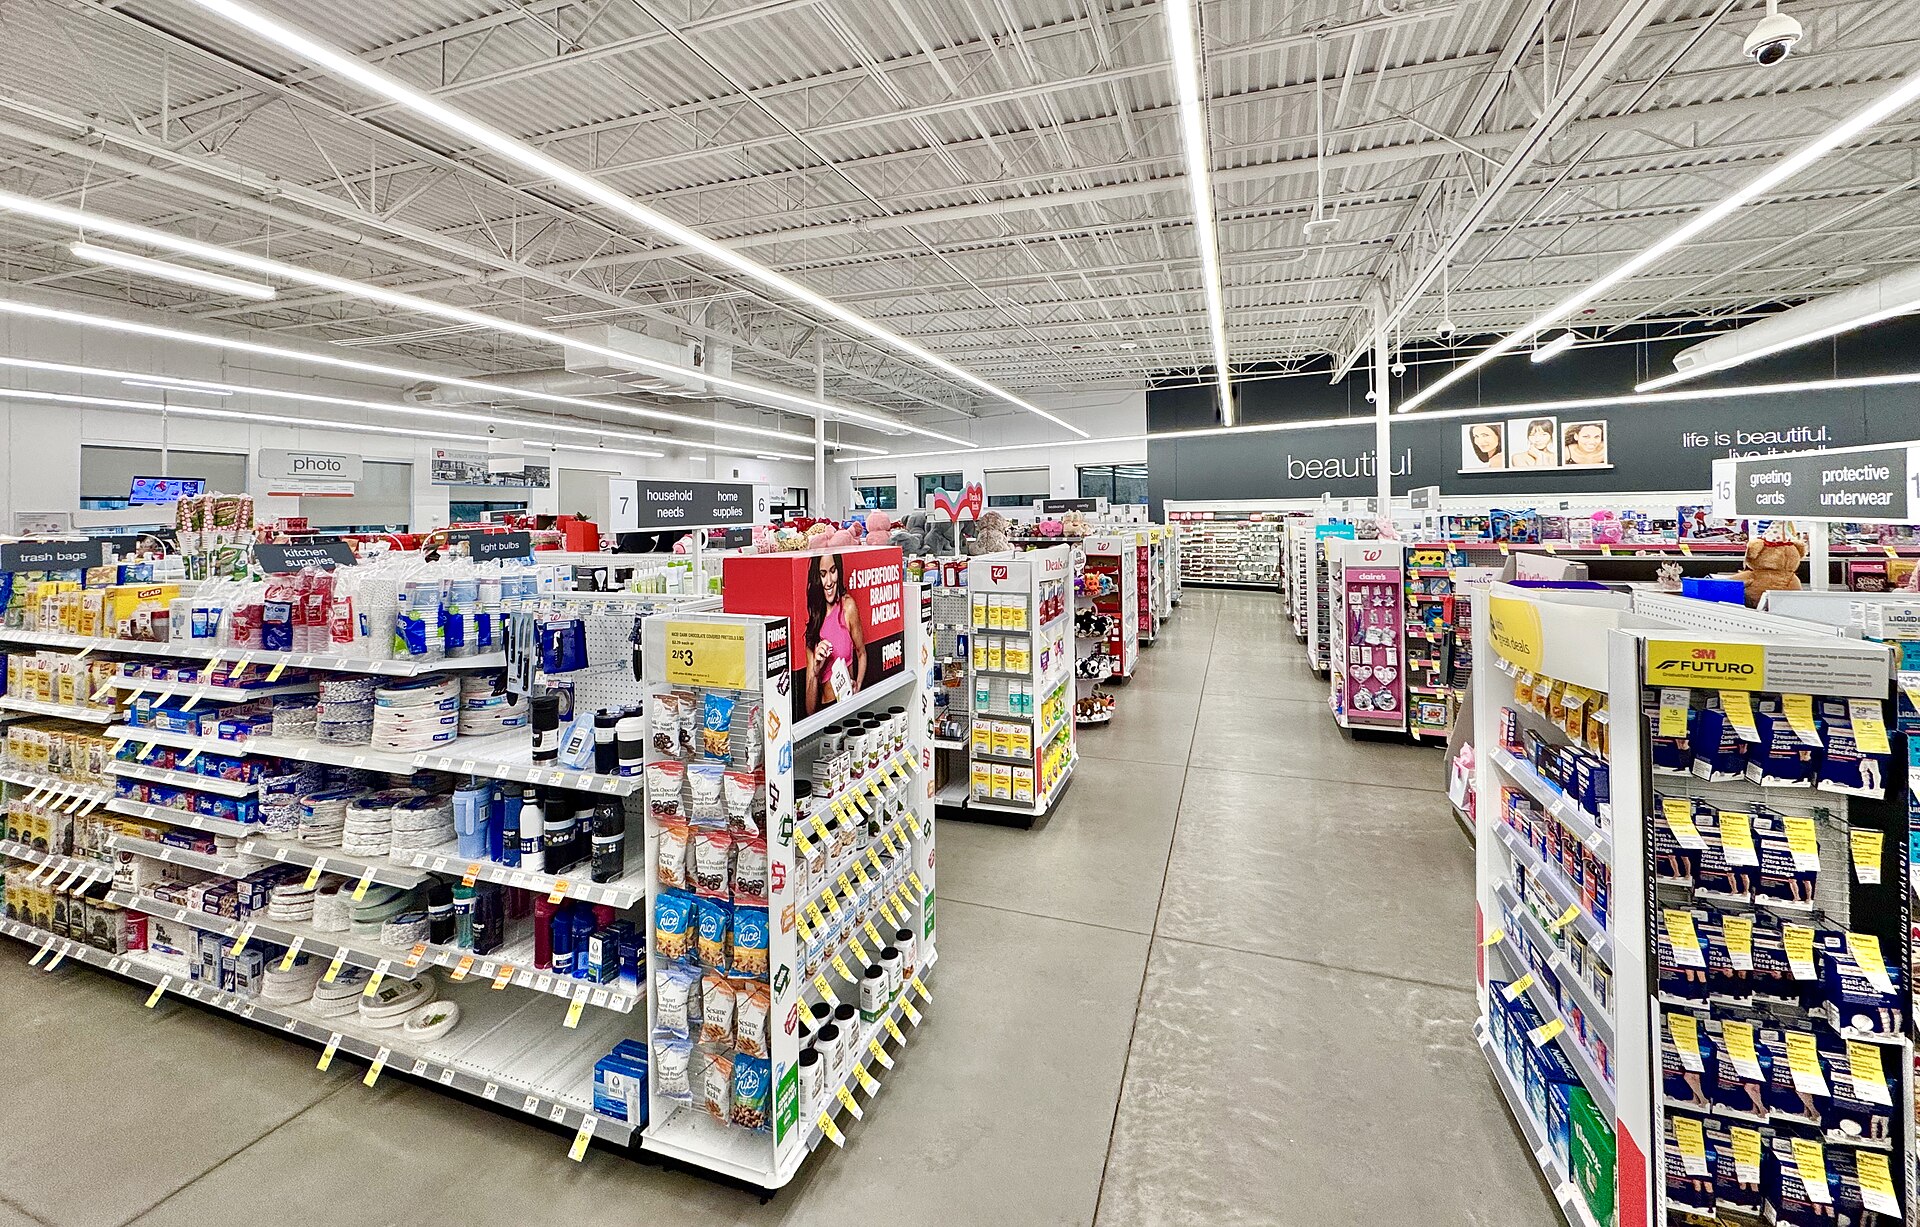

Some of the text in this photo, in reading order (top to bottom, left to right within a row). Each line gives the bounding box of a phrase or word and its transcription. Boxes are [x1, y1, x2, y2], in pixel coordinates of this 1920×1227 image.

[1683, 426, 1832, 448] life is beautiful.
[293, 457, 341, 473] photo
[1287, 449, 1412, 480] beautiul
[1750, 470, 1791, 486] greeting
[1822, 465, 1889, 485] protective
[1716, 481, 1731, 499] 15
[1911, 473, 1920, 498] 1
[646, 489, 738, 502] household home
[1756, 492, 1893, 505] cards underwear
[619, 497, 765, 515] 7 6
[657, 506, 743, 518] needs supplies
[284, 548, 328, 558] kitchen
[480, 542, 520, 553] light bulbs
[20, 552, 87, 564] trash bags
[286, 557, 335, 568] supplies
[1045, 559, 1063, 572] Deals
[857, 564, 900, 589] SUPERFOODS
[1359, 572, 1386, 581] claire's
[138, 588, 162, 598] GLAD
[870, 583, 900, 606] BRAND IN
[871, 602, 900, 626] AMERICA
[768, 626, 787, 644] FORCE
[1511, 637, 1530, 655] deals
[1691, 648, 1716, 660] 3M
[1680, 661, 1754, 675] FUTURO
[1646, 816, 1654, 875] Lifestyle
[1761, 869, 1794, 877] Stockings
[1900, 842, 1909, 991] Lifestyle Compression
[706, 1007, 727, 1016] Sesame
[738, 1019, 759, 1029] Sesame
[706, 1080, 722, 1094] Sesame
